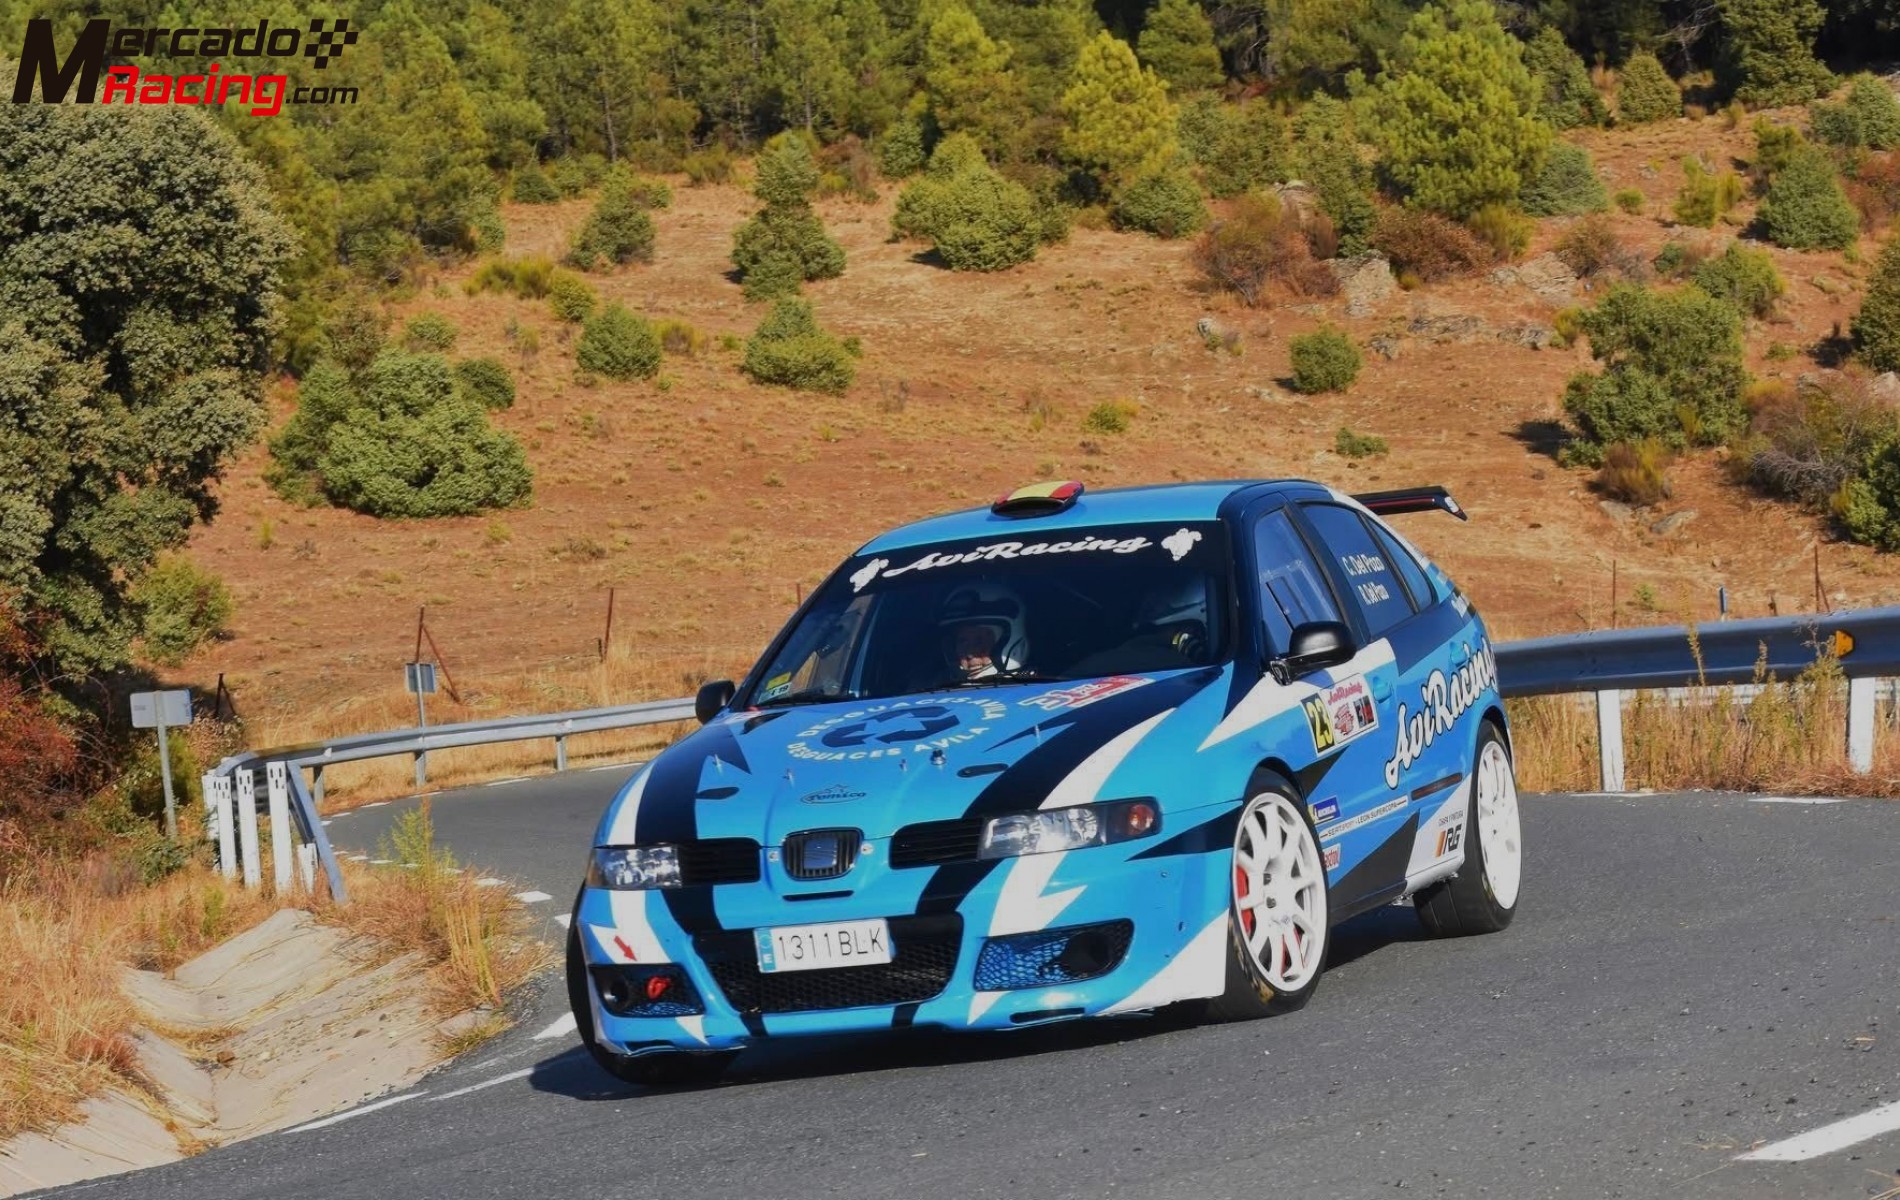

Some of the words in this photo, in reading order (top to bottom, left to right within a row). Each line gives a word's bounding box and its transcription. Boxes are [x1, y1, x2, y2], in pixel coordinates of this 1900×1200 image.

[882, 536, 1153, 578] AviRacing
[796, 697, 971, 737] DESGUACES
[1306, 698, 1333, 749] 23
[1385, 635, 1498, 789] AviRacing
[787, 742, 901, 761] DESGUACES
[913, 726, 990, 752] AVILA
